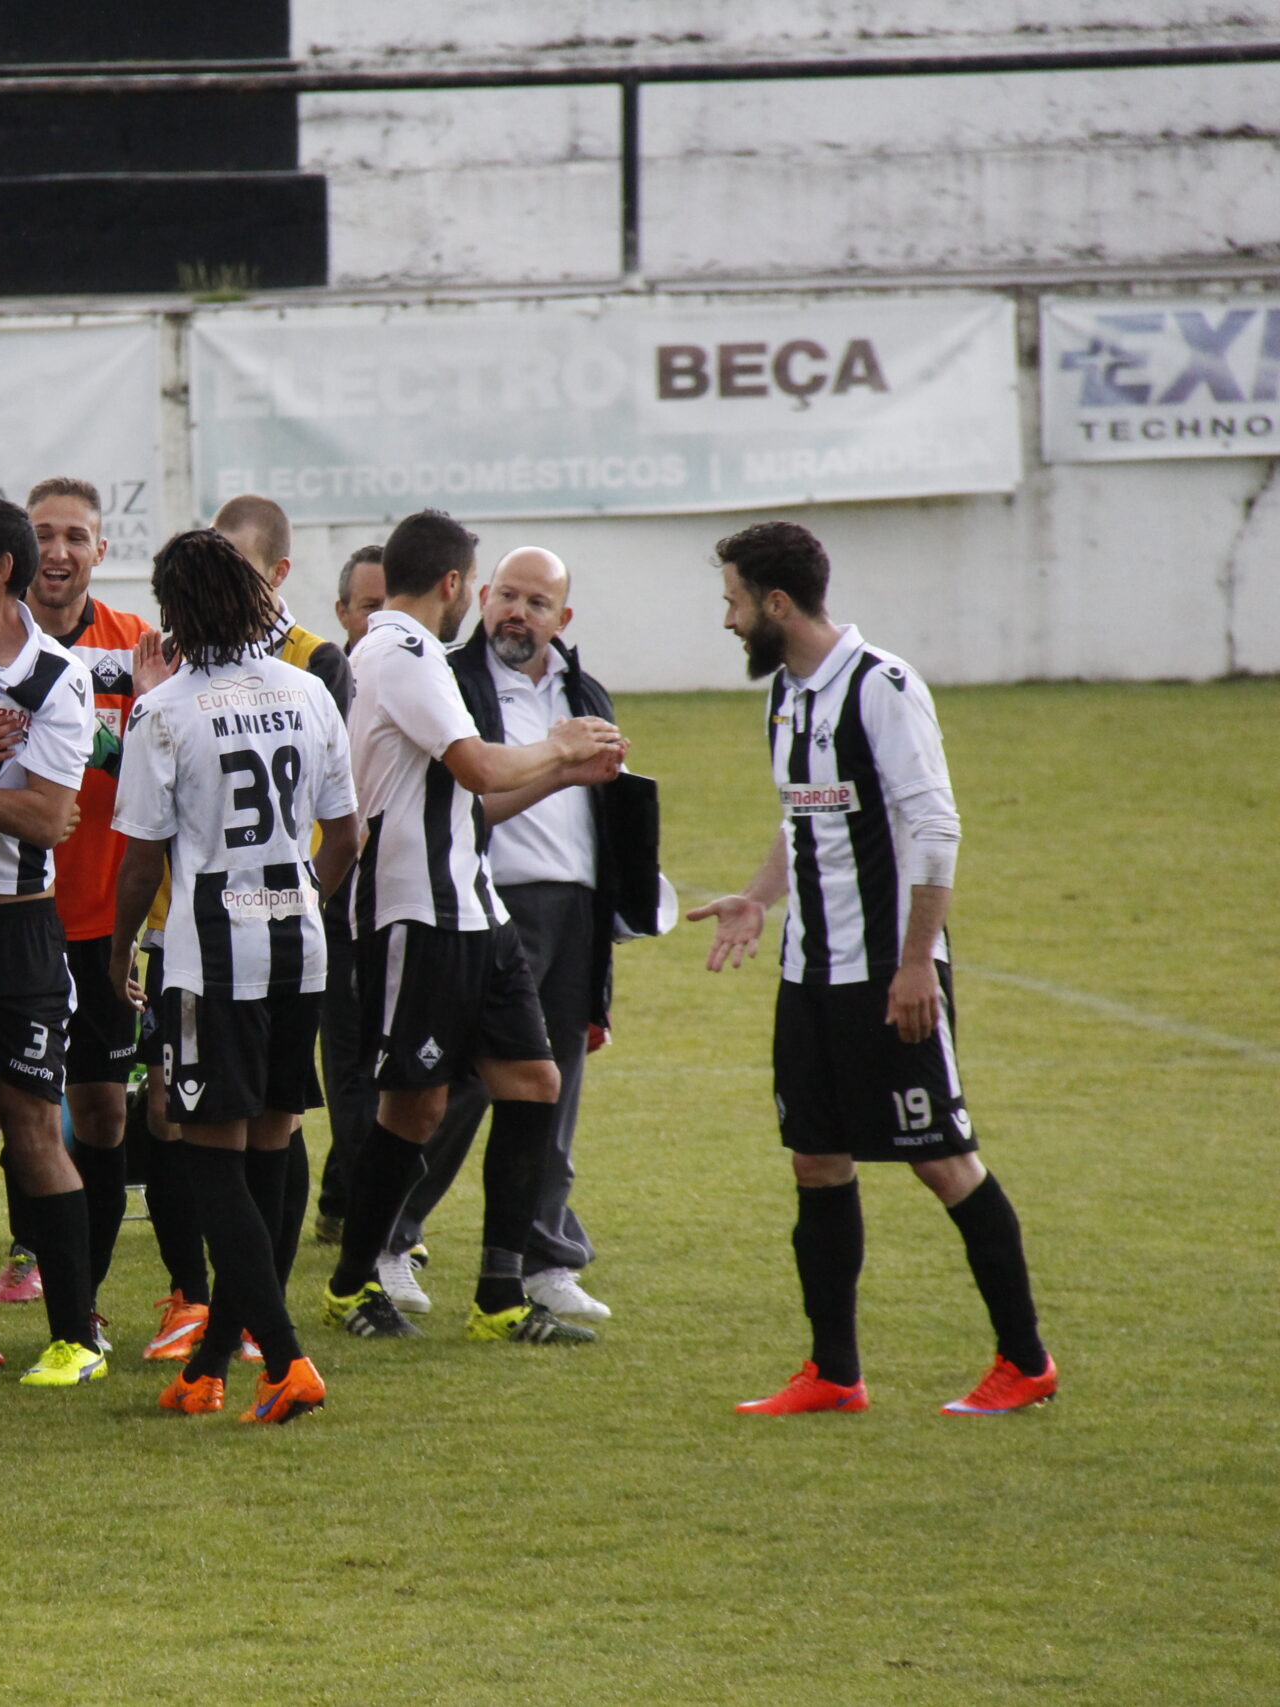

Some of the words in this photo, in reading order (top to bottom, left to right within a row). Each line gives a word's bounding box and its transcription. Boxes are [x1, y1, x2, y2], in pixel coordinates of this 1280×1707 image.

[656, 339, 890, 411] BEÇA
[1062, 309, 1280, 406] EX
[1078, 413, 1275, 442] TECHNO
[217, 453, 687, 499] ELECTRODOMÉSTICOS
[219, 745, 301, 849] 38
[223, 886, 304, 911] Prodipani
[23, 1020, 49, 1060] 3
[892, 1087, 932, 1131] 19
